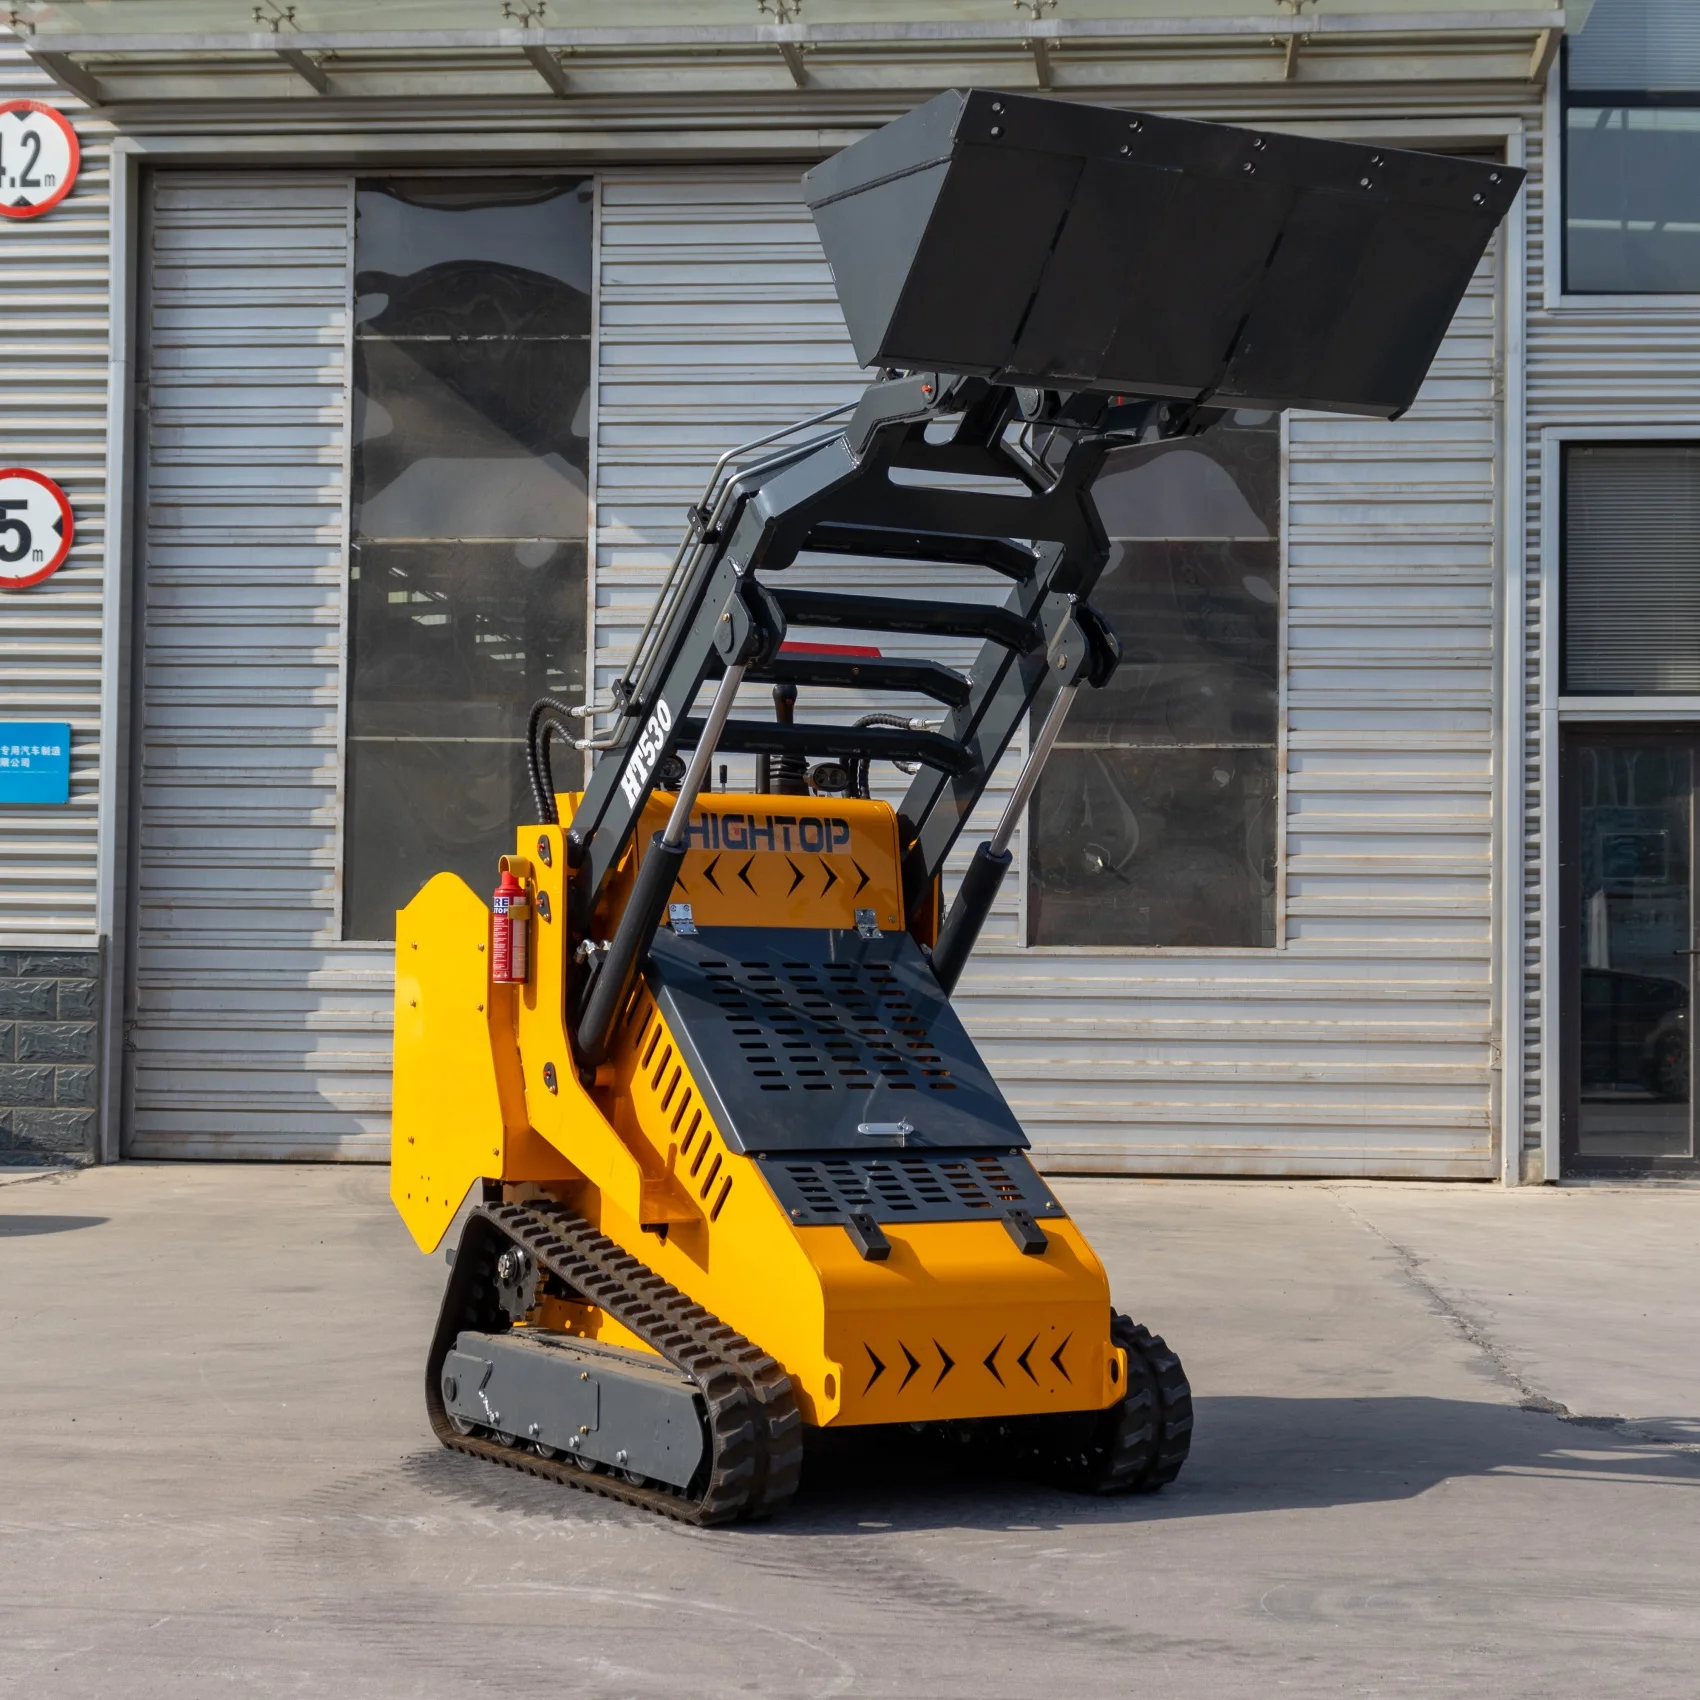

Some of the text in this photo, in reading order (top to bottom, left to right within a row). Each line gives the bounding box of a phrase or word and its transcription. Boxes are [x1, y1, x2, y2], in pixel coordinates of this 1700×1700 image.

[44, 174, 56, 187] m
[32, 548, 44, 562] m
[0, 745, 61, 756] 专用汽车制造
[620, 699, 672, 810] HT530
[685, 812, 850, 853] HIGHTOP
[494, 898, 508, 906] RE
